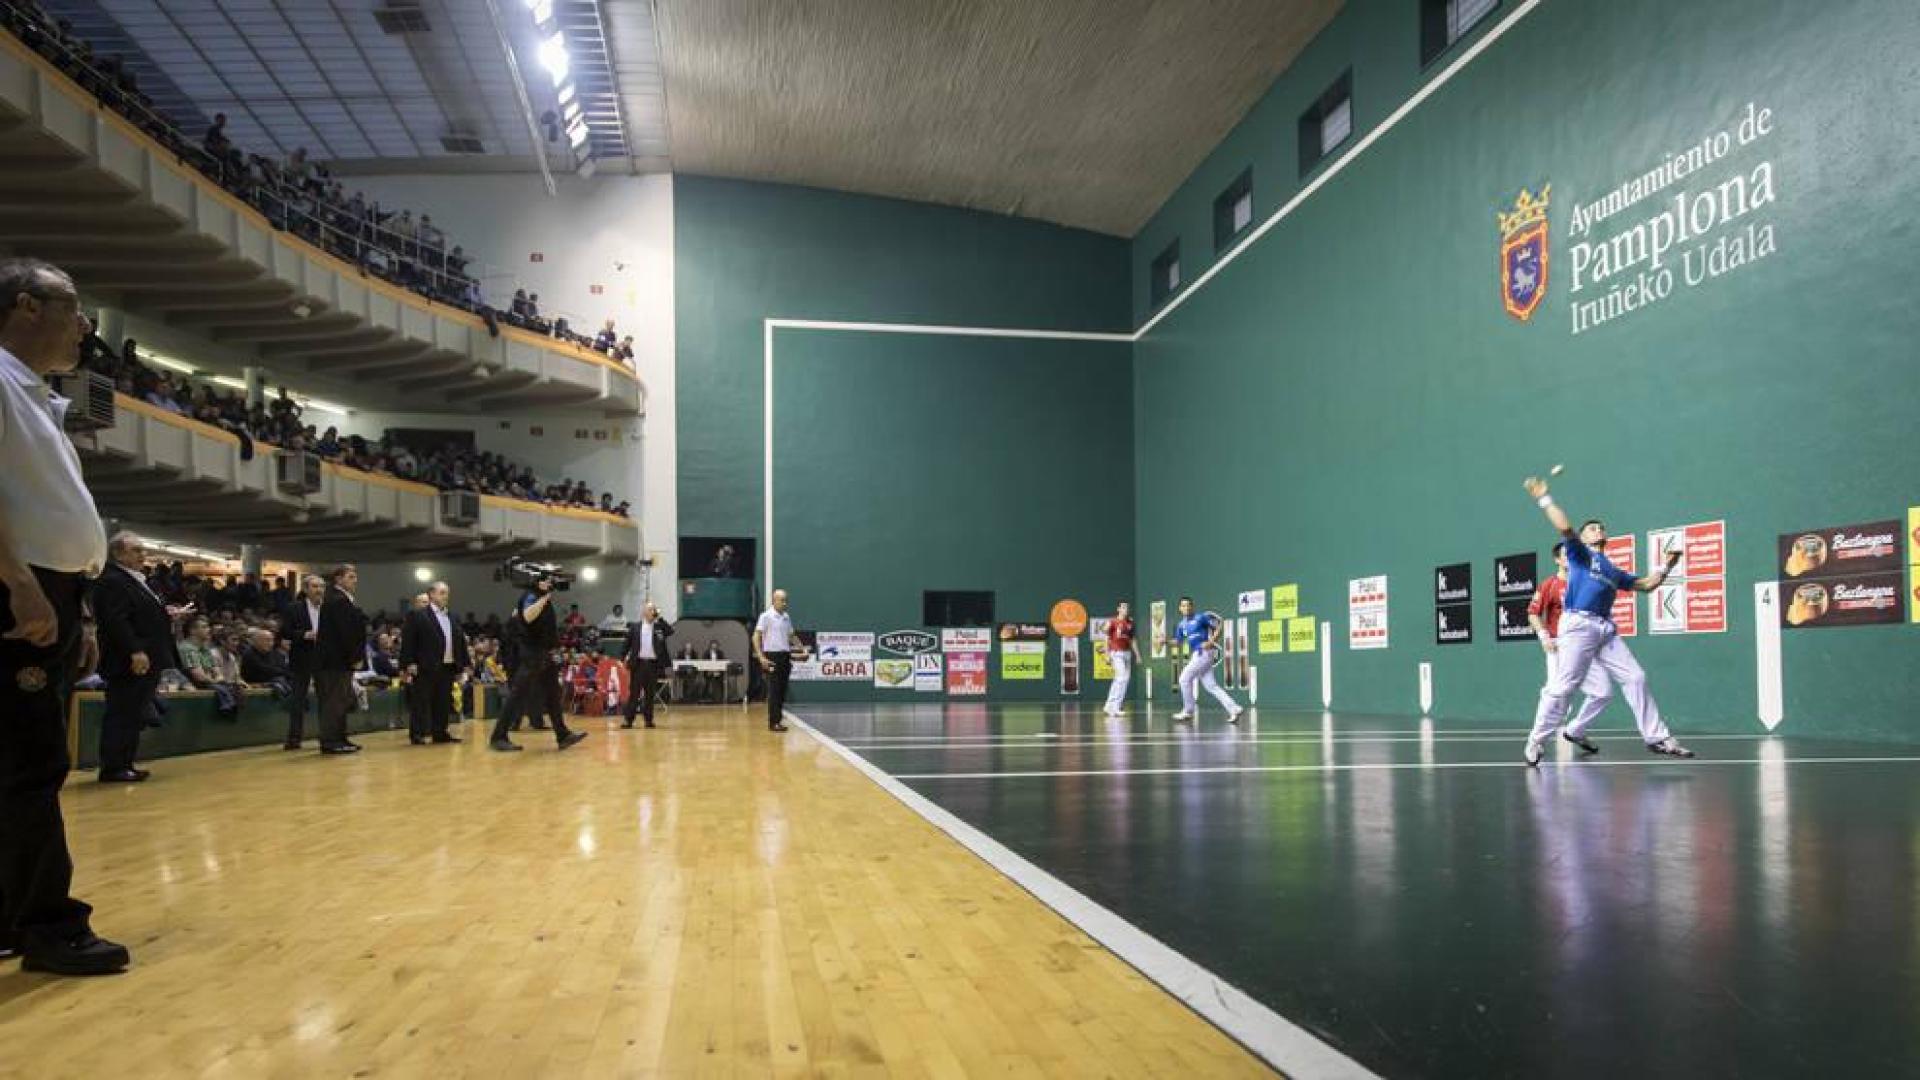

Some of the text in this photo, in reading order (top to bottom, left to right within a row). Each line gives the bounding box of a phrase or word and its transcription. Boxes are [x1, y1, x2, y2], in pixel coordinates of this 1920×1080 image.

[1569, 102, 1773, 236] Ayuntamiento de
[1569, 160, 1775, 292] Pamplona
[1570, 223, 1777, 334] Iruñeko Udala
[1762, 587, 1772, 604] 4
[821, 662, 867, 677] GARA
